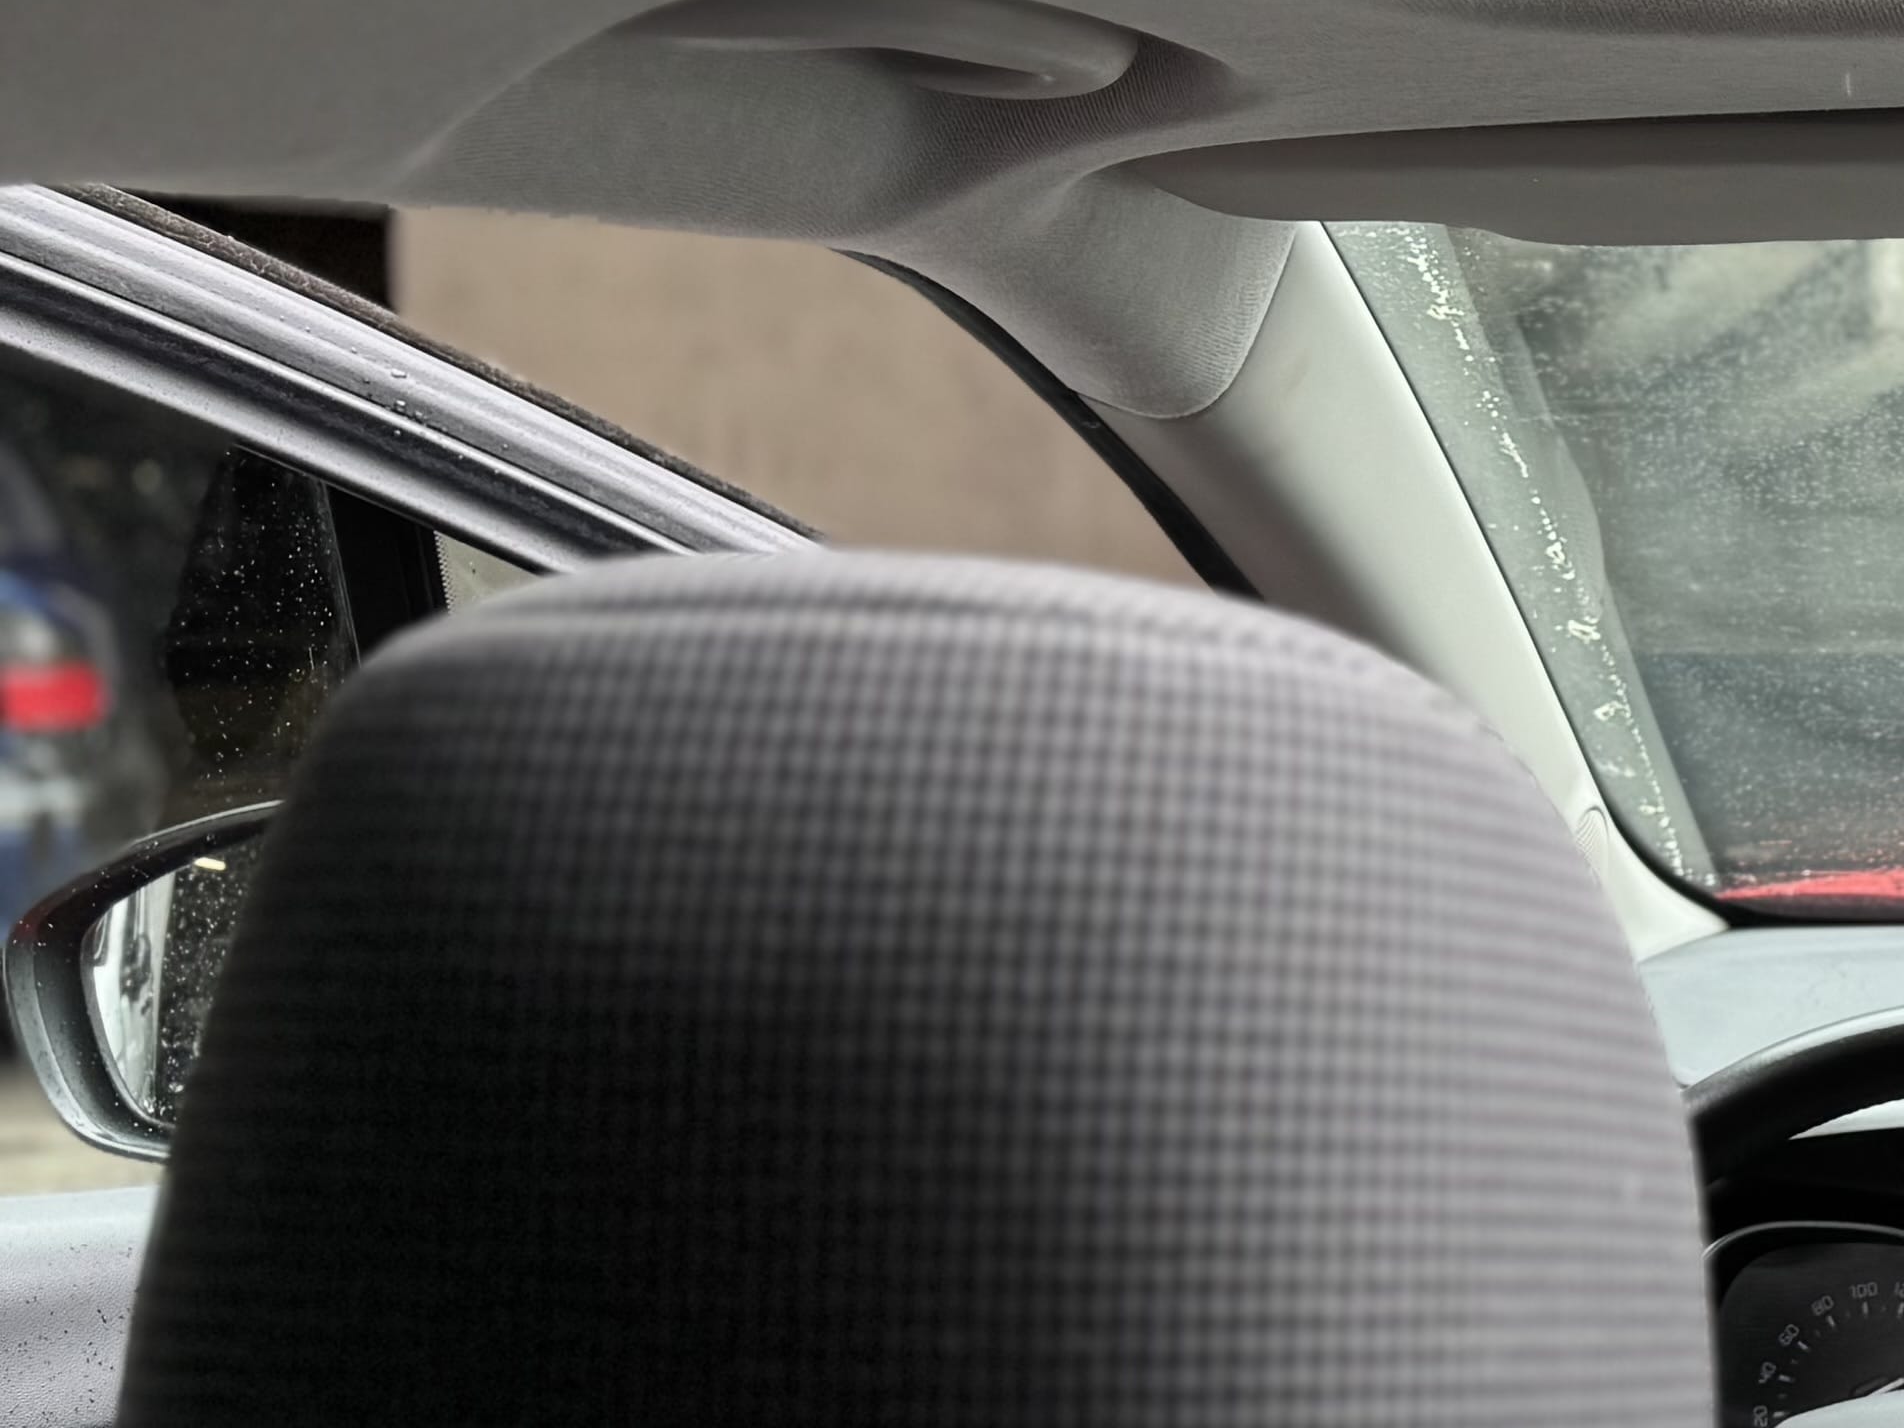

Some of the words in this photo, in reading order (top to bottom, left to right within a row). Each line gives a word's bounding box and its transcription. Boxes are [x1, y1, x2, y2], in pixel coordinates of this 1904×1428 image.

[1849, 1281, 1878, 1299] 100
[1811, 1295, 1835, 1317] 80
[1758, 1361, 1777, 1384] 40
[1752, 1404, 1769, 1428] 20
